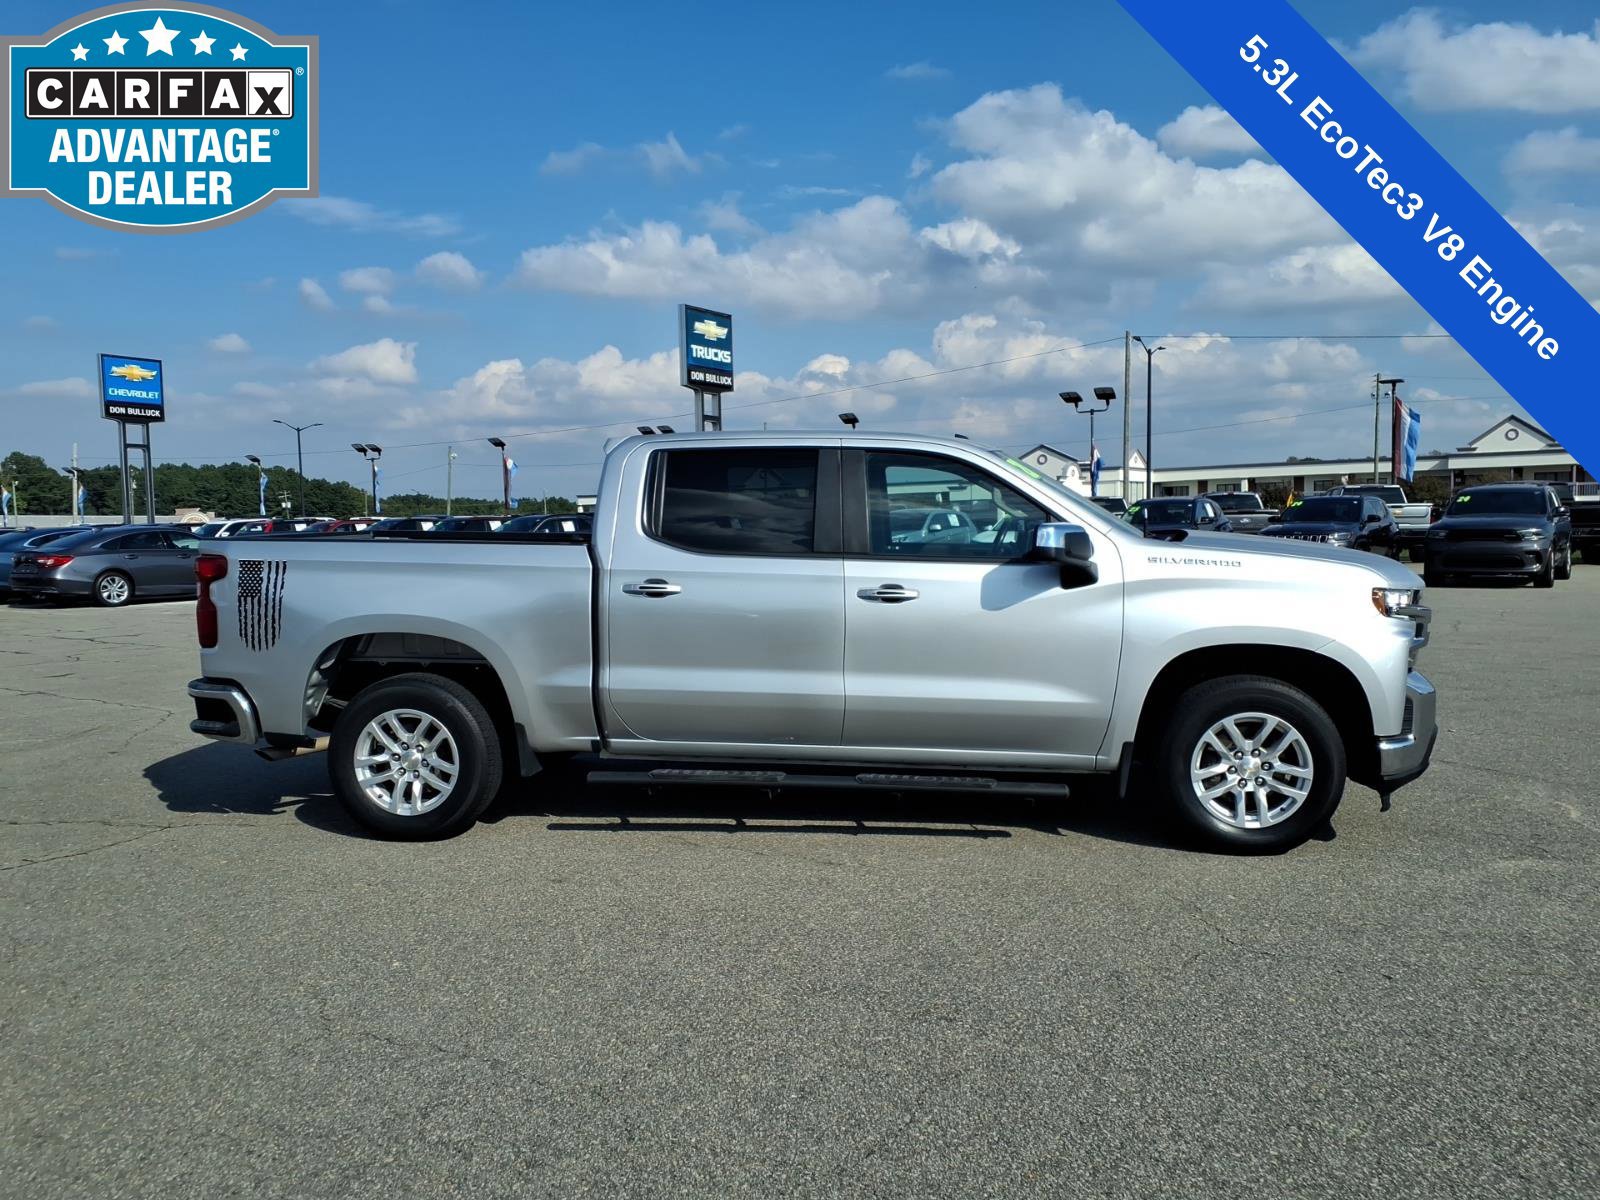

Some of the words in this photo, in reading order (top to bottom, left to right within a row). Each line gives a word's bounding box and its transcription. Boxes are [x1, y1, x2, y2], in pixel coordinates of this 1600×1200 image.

[690, 344, 732, 363] TRUCKS
[690, 370, 705, 381] DON
[705, 373, 732, 385] BULLUCK
[108, 387, 160, 399] CHEVROLET
[109, 406, 126, 414] DON
[127, 407, 161, 417] BULLUCK
[1147, 556, 1242, 568] SILVERADO
